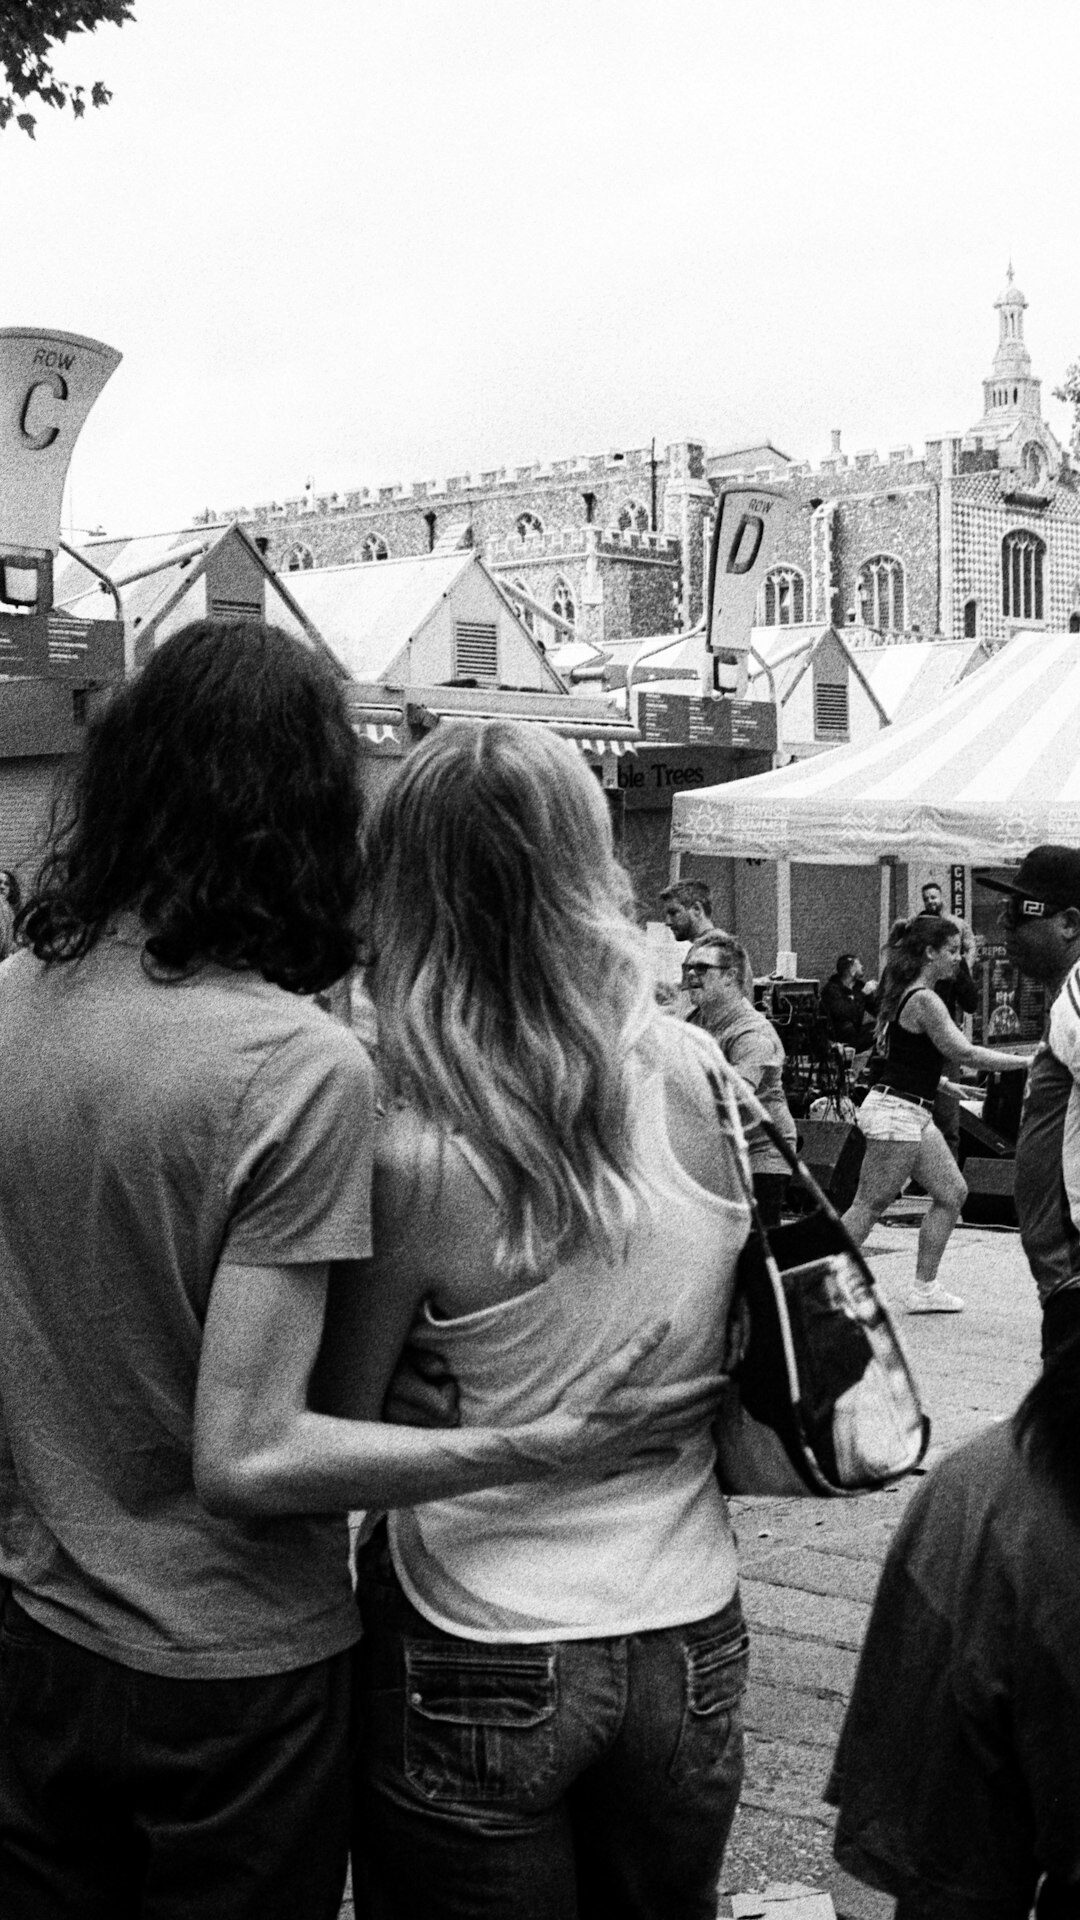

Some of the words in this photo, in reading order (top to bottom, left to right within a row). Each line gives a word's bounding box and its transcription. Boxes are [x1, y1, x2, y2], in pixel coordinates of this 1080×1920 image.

[33, 348, 76, 370] ROW
[20, 373, 68, 451] C
[748, 498, 774, 514] ROW
[726, 513, 764, 575] D
[650, 762, 704, 788] Trees
